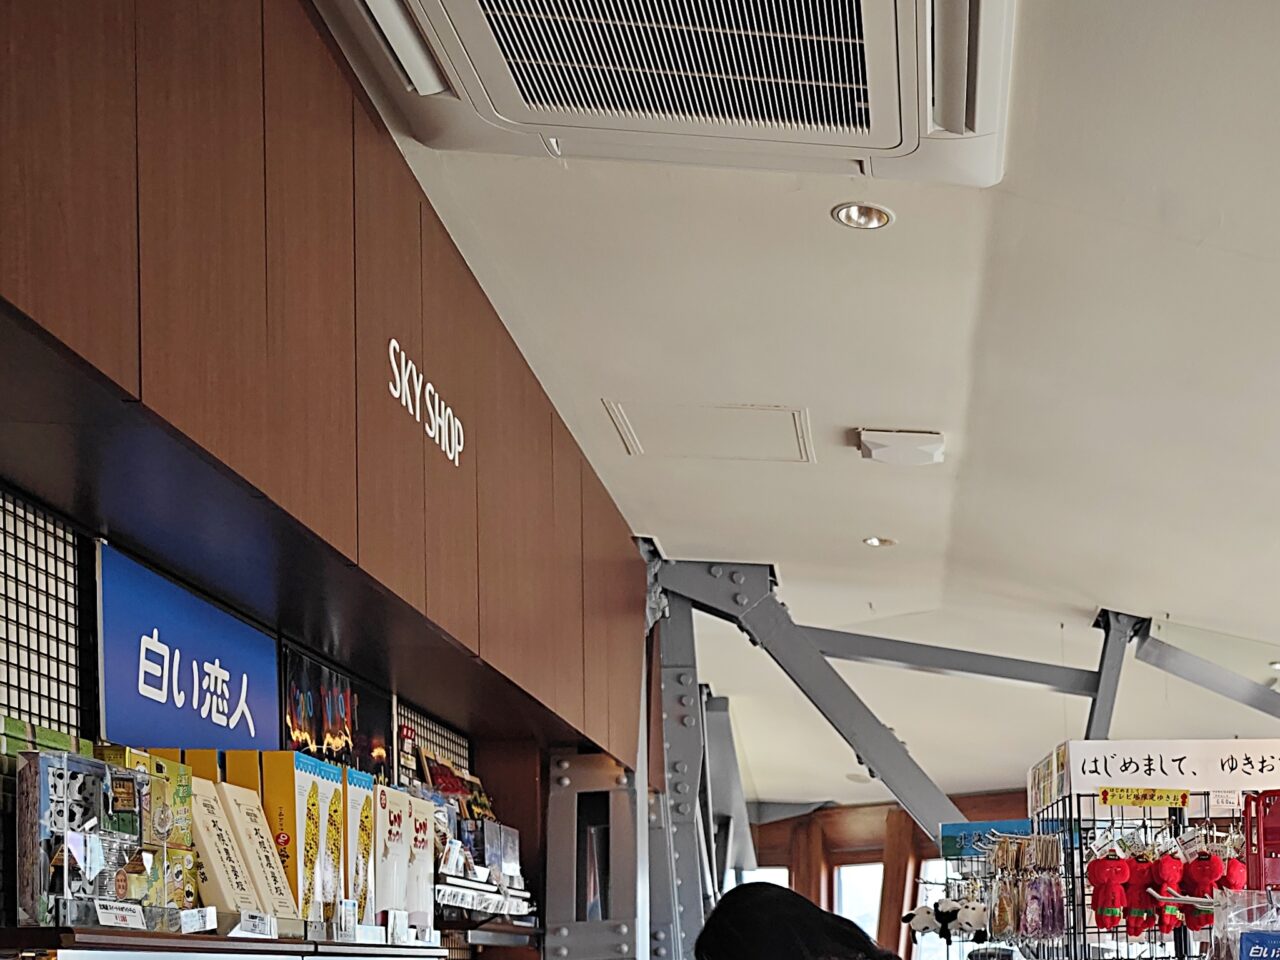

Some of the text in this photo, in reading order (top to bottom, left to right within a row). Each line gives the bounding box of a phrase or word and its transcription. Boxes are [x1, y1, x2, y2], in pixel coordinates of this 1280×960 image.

[388, 338, 465, 467] SKY SHOP
[137, 627, 256, 737] 白い恋人
[1081, 752, 1198, 778] はじめまして、
